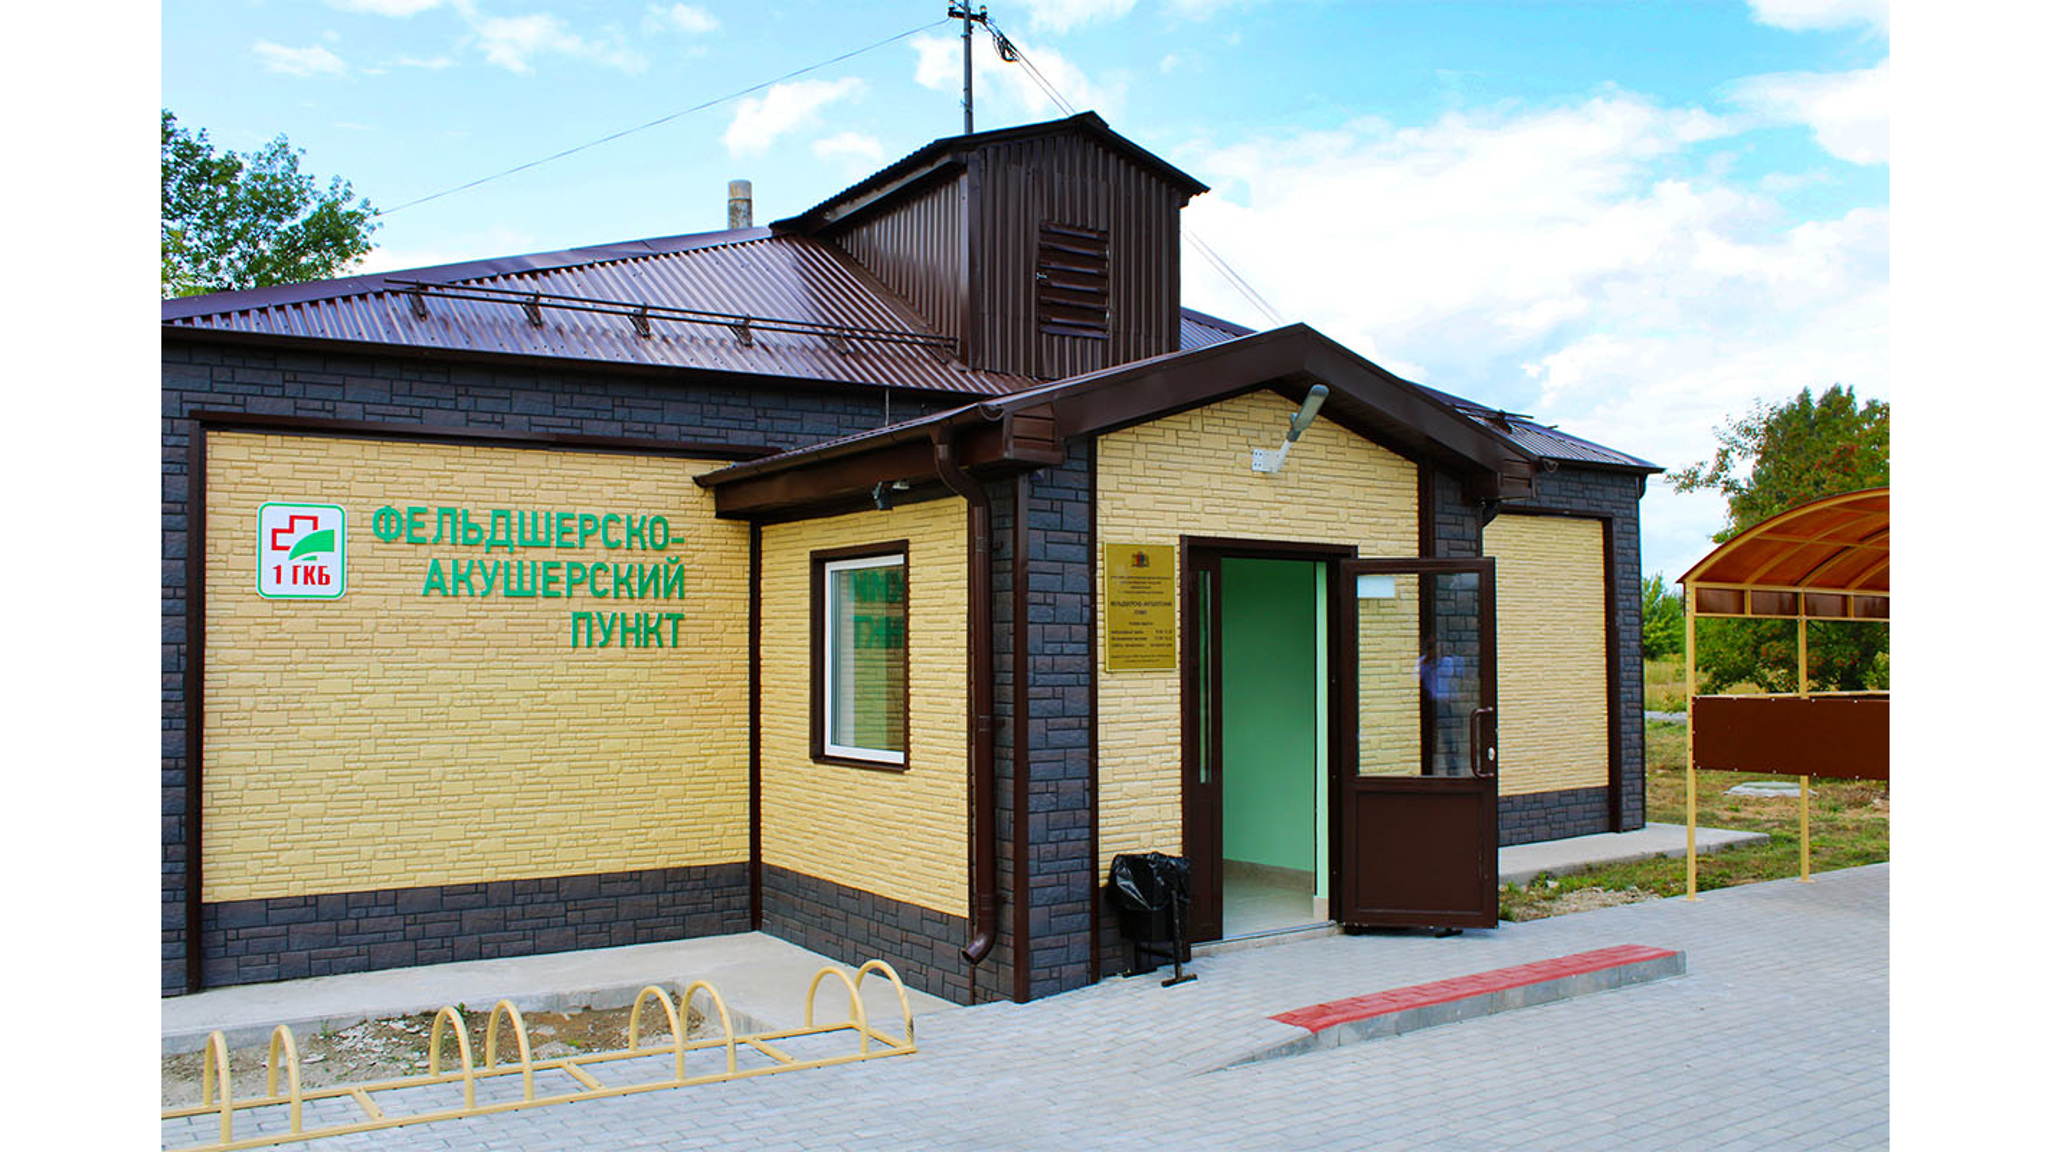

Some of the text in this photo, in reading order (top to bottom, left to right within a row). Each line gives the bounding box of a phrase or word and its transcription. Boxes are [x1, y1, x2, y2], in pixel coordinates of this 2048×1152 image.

[372, 505, 685, 553] ФЕЛЬДШЕРСКО-
[272, 564, 331, 586] 1 ГКБ
[422, 556, 685, 599] АКУШЕРСКИЙ
[570, 611, 685, 649] ПУНКТ
